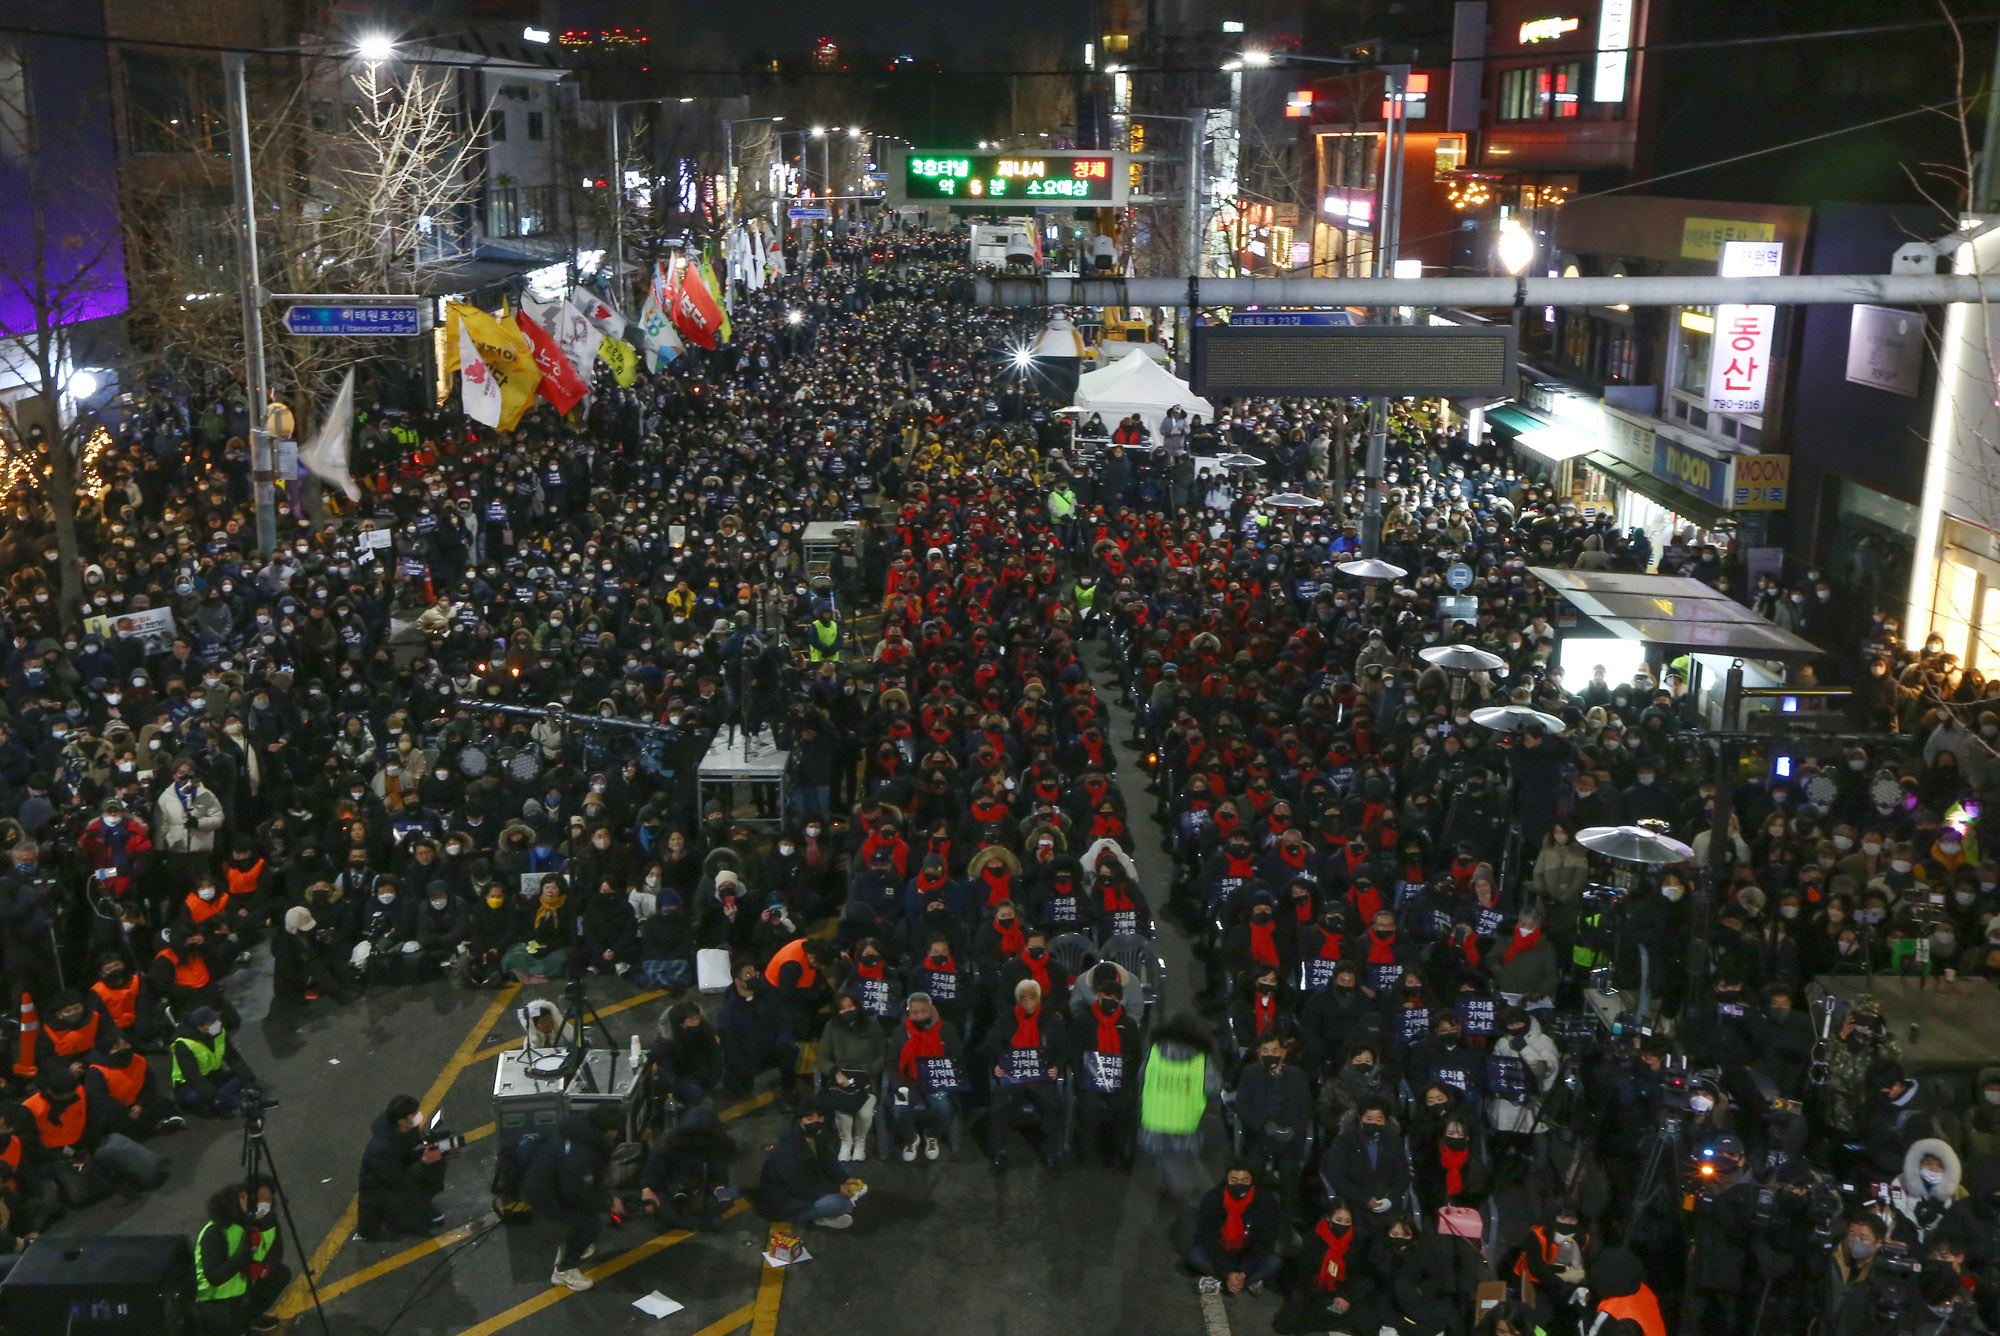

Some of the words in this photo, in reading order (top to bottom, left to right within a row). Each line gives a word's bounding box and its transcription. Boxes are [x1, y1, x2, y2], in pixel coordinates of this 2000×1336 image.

[911, 159, 969, 177] 3호터널
[997, 160, 1045, 177] 지나서
[1073, 161, 1106, 177] 정체
[938, 179, 956, 195] 약
[969, 179, 983, 195] 5
[989, 179, 1006, 196] 분
[1025, 179, 1089, 196] 소요예상
[342, 309, 416, 322] 이태원로26길
[1723, 304, 1761, 391] 동산
[1713, 399, 1760, 410] 790-9116
[1666, 446, 1711, 490] moon
[1737, 460, 1788, 482] MOON
[1054, 897, 1077, 906] 우리를
[1113, 911, 1137, 920] 우리를
[1313, 959, 1336, 970] 우리를
[1380, 965, 1404, 975] 우리를
[932, 972, 956, 983] 우리를
[864, 980, 889, 992] 우리를
[931, 981, 957, 991] 기억해
[863, 991, 889, 1002] 기억해
[863, 1001, 888, 1014] 주세요
[1468, 1001, 1494, 1011] 우리를
[1404, 1008, 1429, 1018] 우리를
[1468, 1011, 1494, 1020] 기억해
[1404, 1018, 1429, 1027] 기억해
[1467, 1021, 1494, 1030] 주세요
[1011, 1050, 1039, 1059] 우리를
[927, 1059, 953, 1069] 우리를
[1012, 1059, 1040, 1068] 기억해
[1097, 1055, 1124, 1067] 우리를
[929, 1069, 955, 1078] 기억해
[1013, 1068, 1041, 1078] 주세요
[1439, 1069, 1465, 1081] 우리를
[931, 1078, 958, 1087] 주세요
